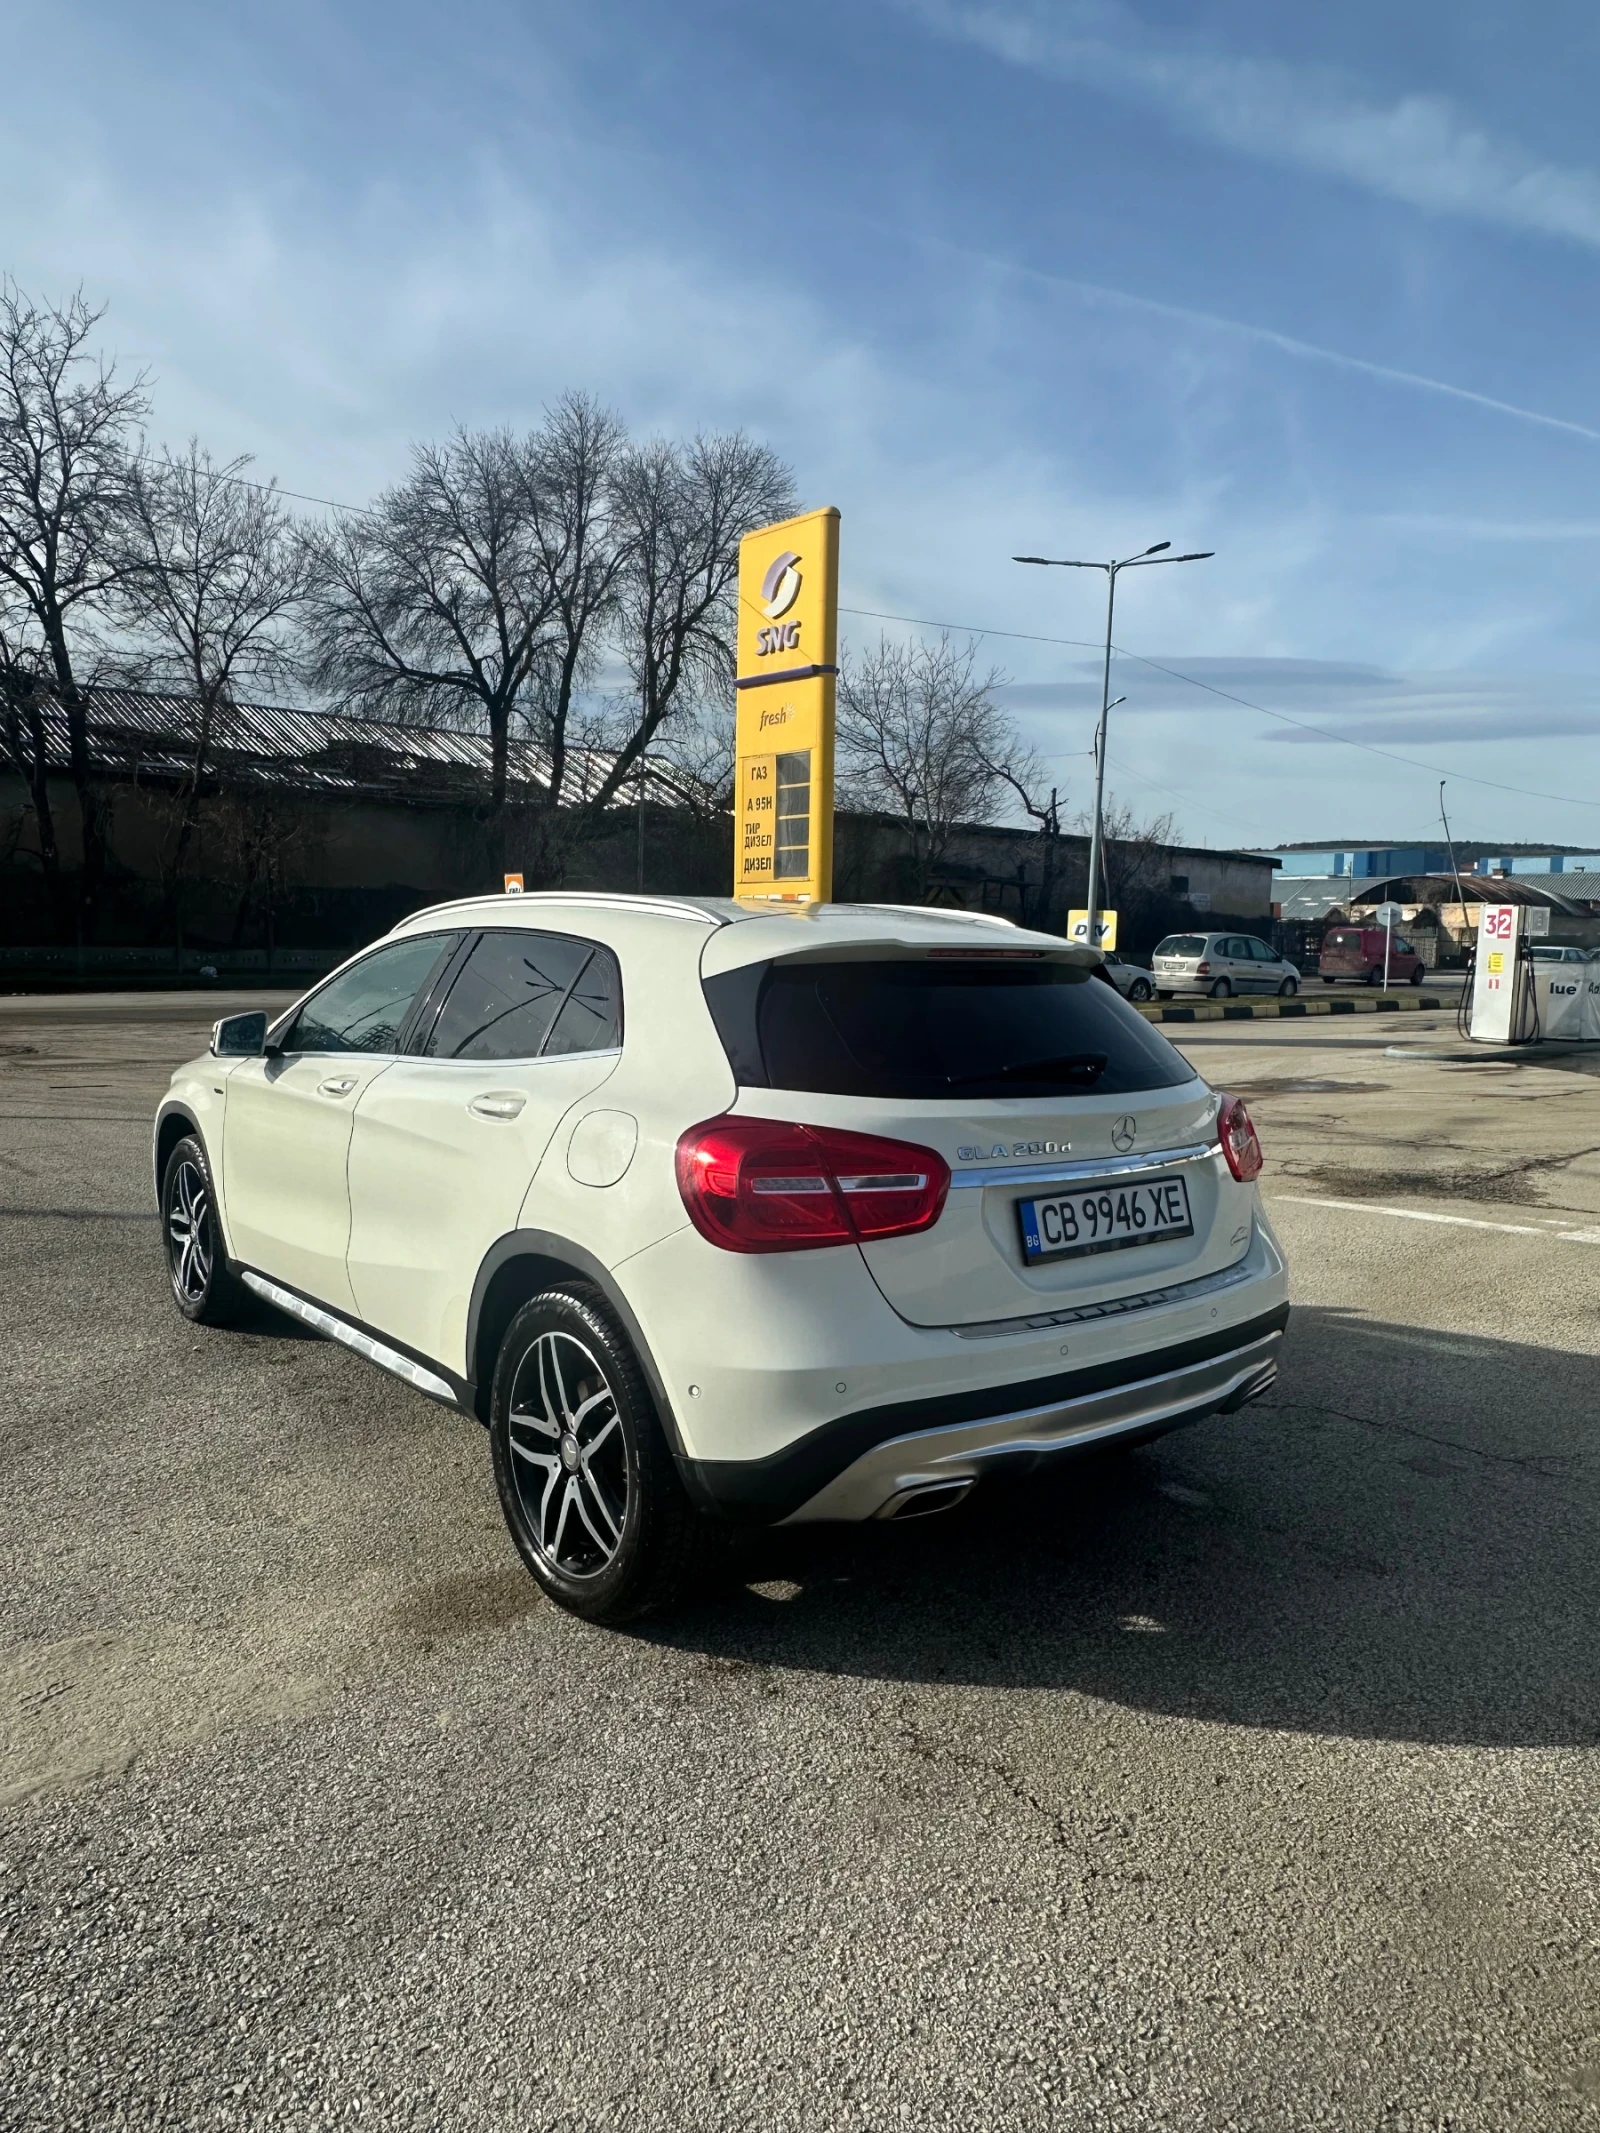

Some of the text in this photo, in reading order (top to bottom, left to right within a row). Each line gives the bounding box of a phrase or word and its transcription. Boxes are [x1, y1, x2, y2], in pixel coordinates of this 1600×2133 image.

[755, 621, 801, 656] SNG
[760, 707, 787, 732] fresh
[751, 766, 768, 780] ГАЗ
[745, 822, 761, 835] ТИР
[744, 835, 772, 849] ДИЗЕЛ
[743, 857, 772, 874] ДИЗЕЛ
[1074, 924, 1110, 937] DV
[1485, 913, 1511, 935] 32
[1549, 982, 1577, 995] lue
[957, 1144, 1009, 1161] GLA
[1041, 1185, 1185, 1245] CB 9946 XE
[1026, 1234, 1041, 1248] BG
